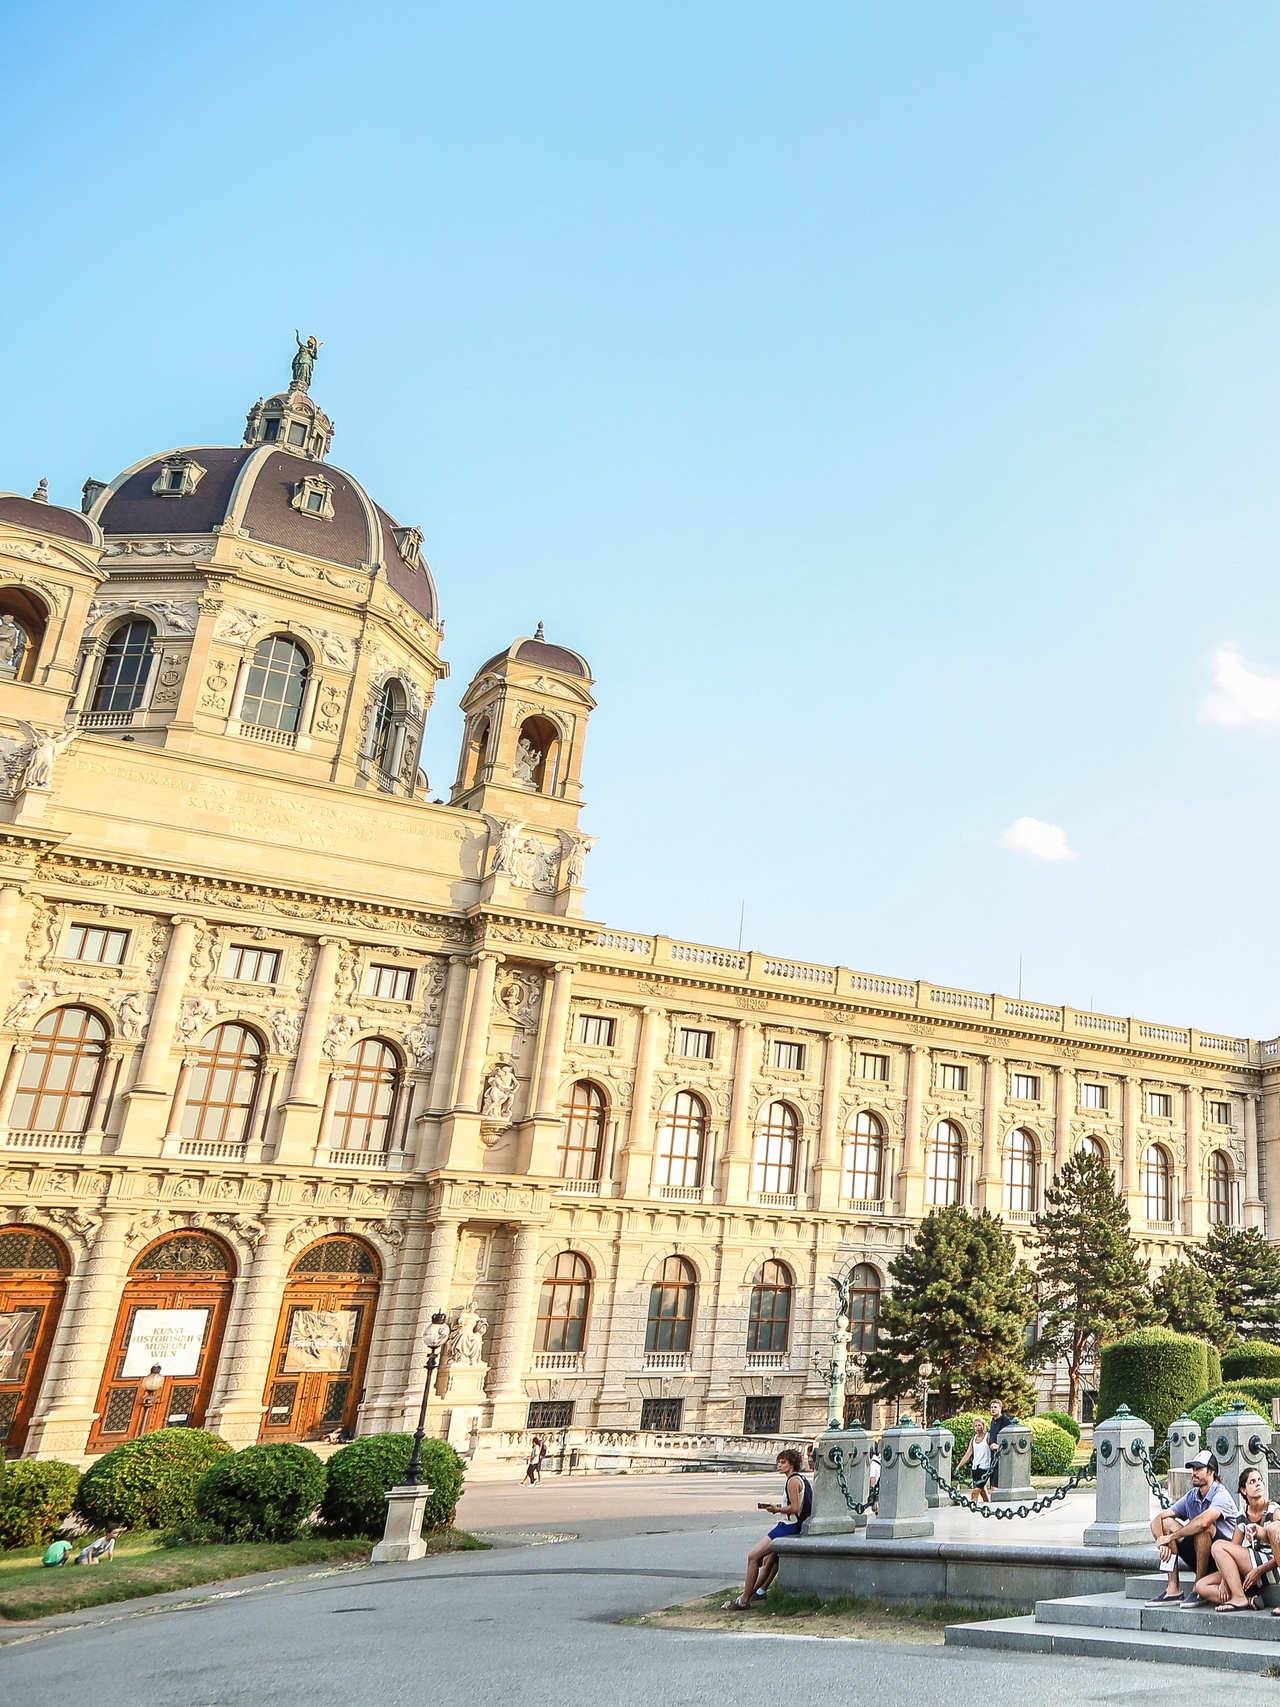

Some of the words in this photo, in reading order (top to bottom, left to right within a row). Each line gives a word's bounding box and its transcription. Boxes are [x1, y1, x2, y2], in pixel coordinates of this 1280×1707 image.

[76, 760, 111, 776] DEN
[234, 790, 264, 805] DER
[267, 796, 316, 814] KUNST
[319, 806, 348, 821] UND
[352, 813, 379, 827] DES
[187, 796, 247, 816] KAISER
[253, 809, 301, 826] FRANZ
[307, 819, 364, 839] JOSEPH
[153, 1327, 184, 1335] KUNST
[144, 1343, 187, 1351] MUSEUM
[150, 1350, 177, 1358] WIEN
